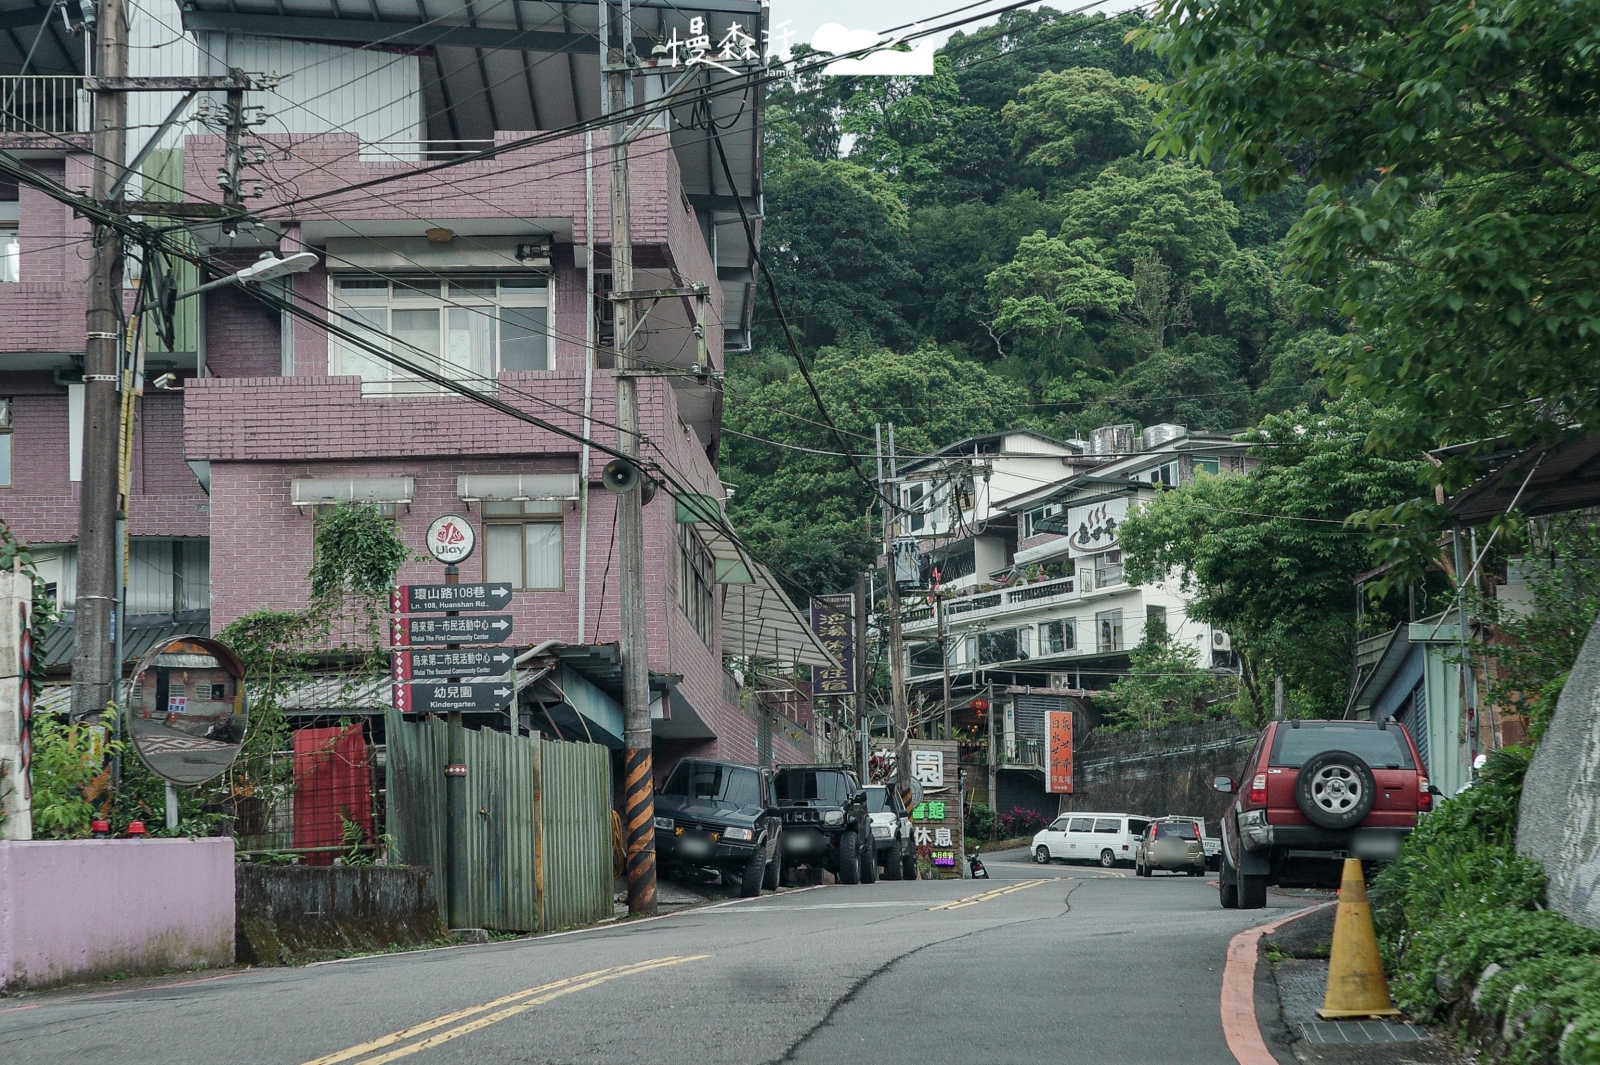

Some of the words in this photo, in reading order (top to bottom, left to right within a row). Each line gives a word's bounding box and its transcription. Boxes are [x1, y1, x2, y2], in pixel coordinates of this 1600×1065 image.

[414, 586, 485, 600] 環山路108巷
[411, 619, 489, 633] 烏來第一市民活動中心
[446, 634, 473, 642] Community
[412, 652, 491, 667] 烏來第二市民活動中心
[452, 667, 476, 675] Community
[434, 686, 472, 699] 幼兒園
[430, 701, 476, 709] Kindergarten
[914, 826, 953, 847] 休息
